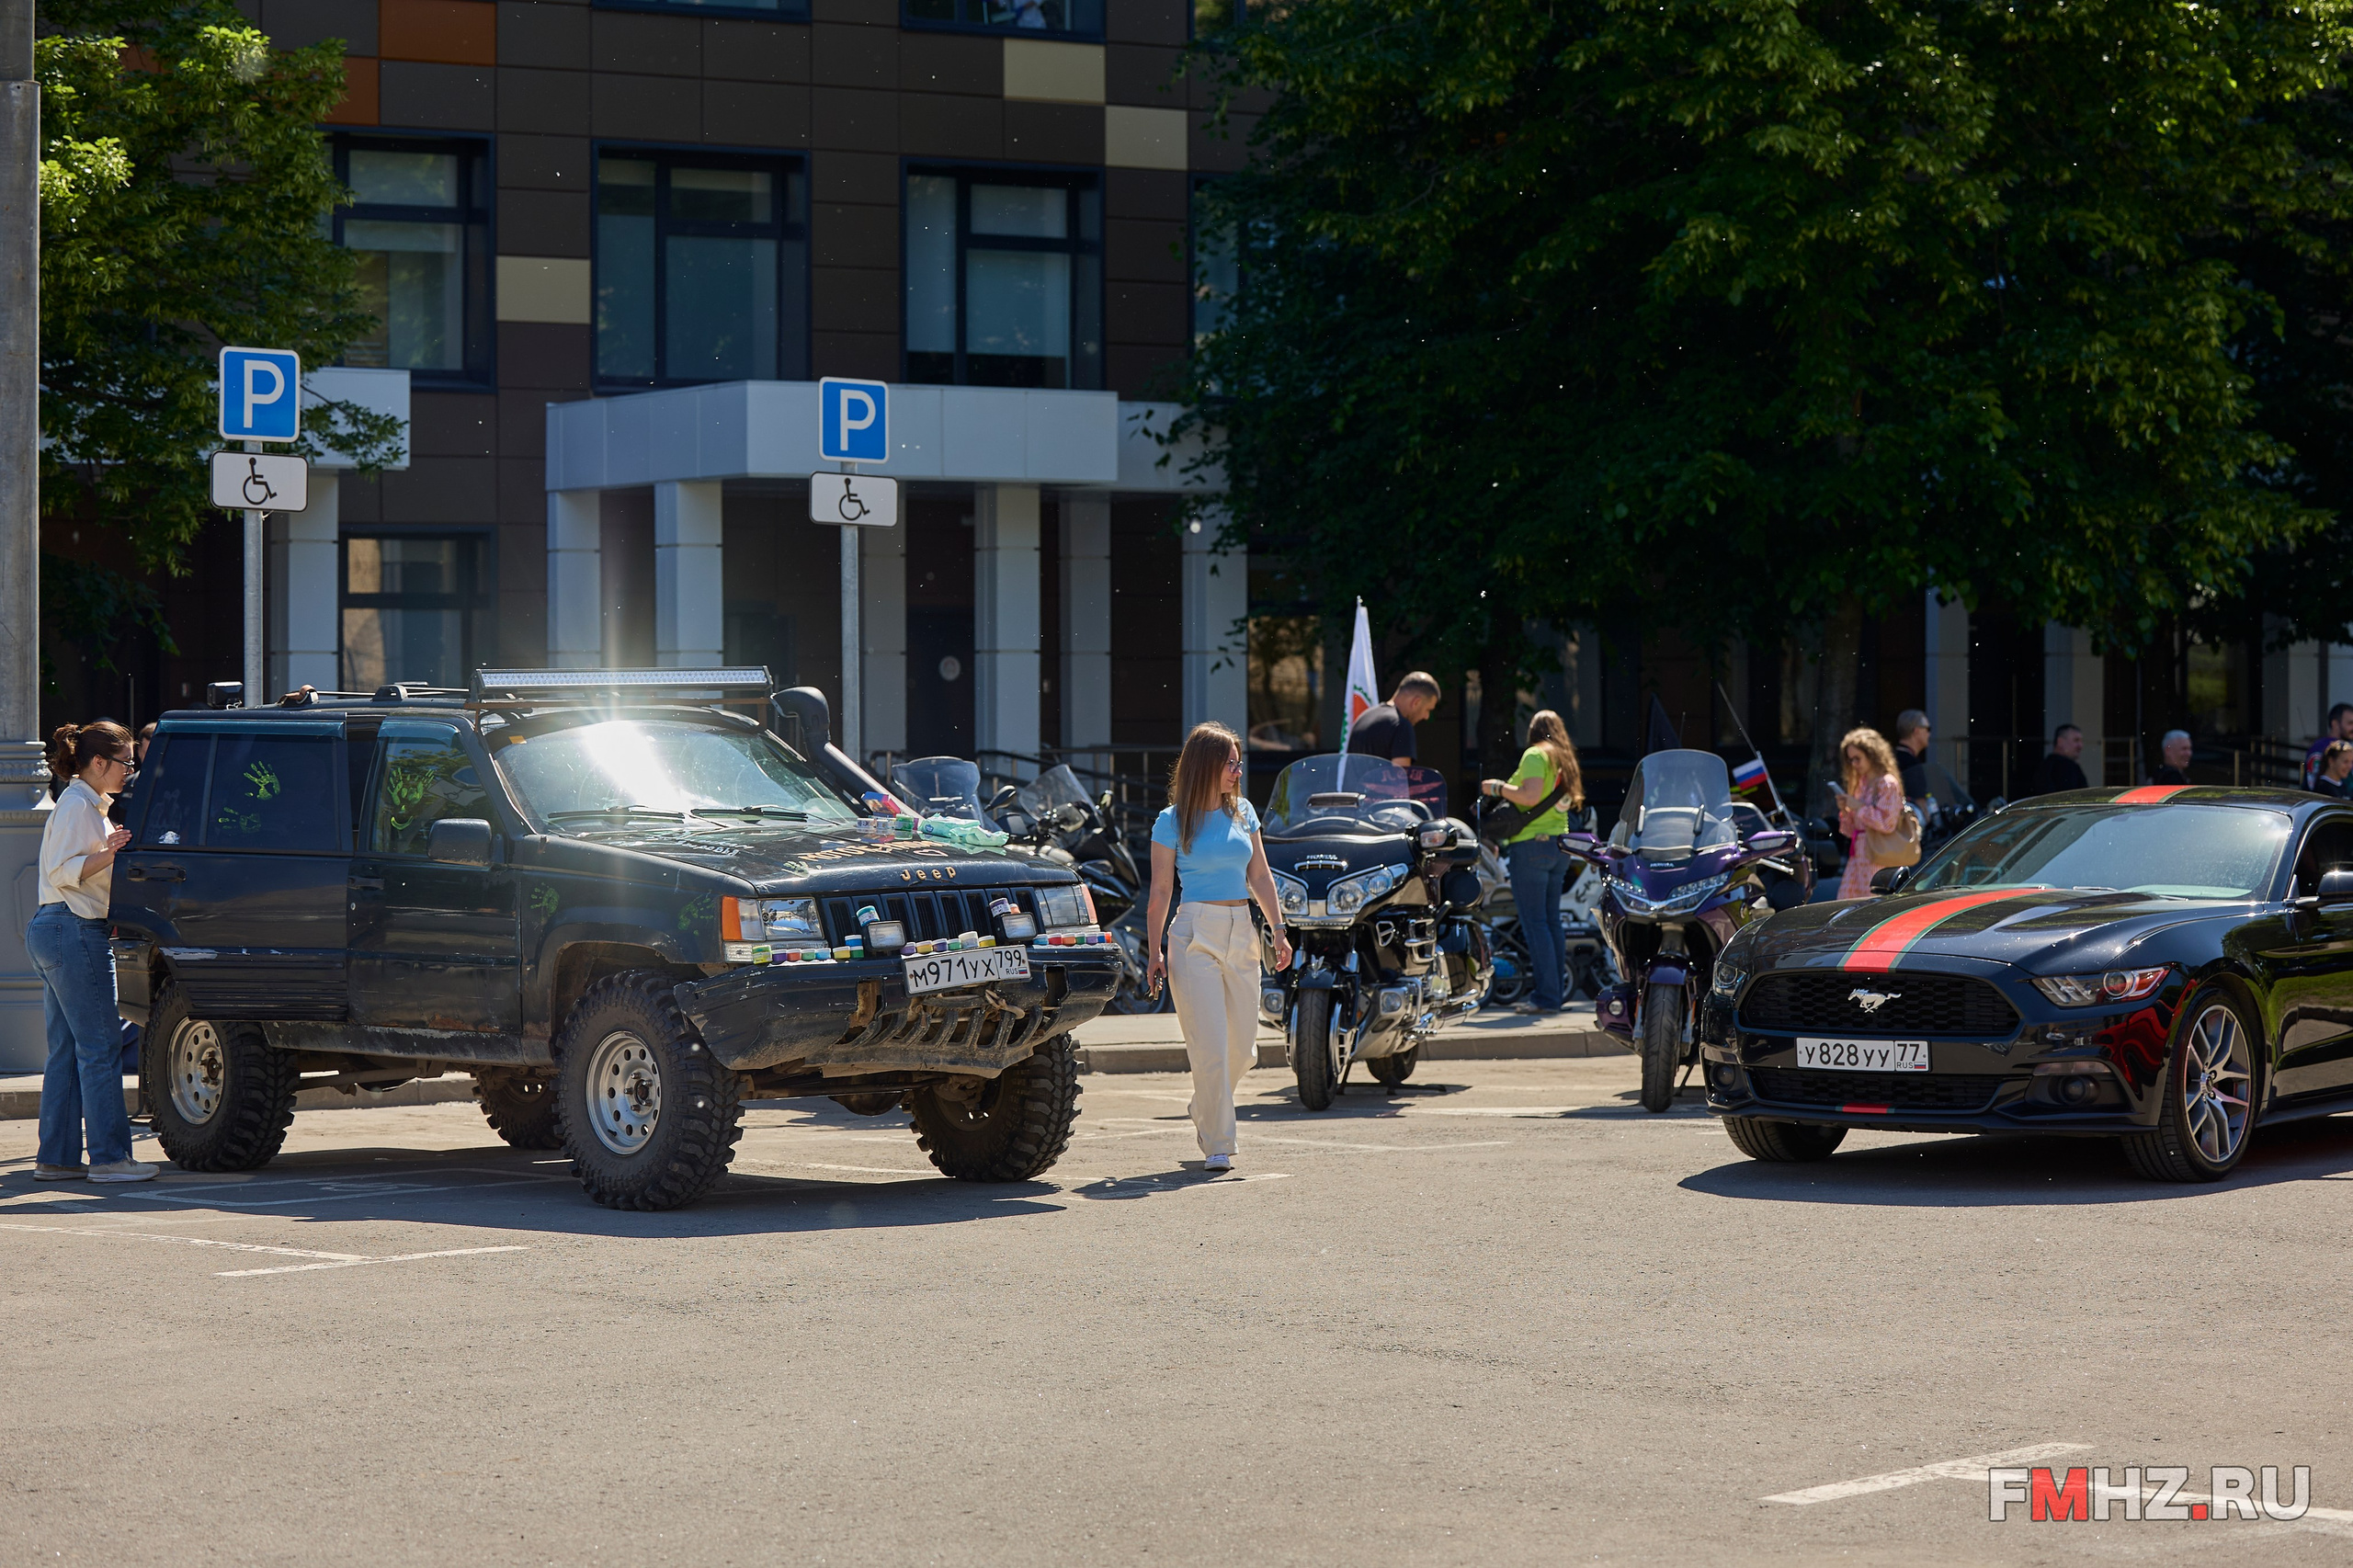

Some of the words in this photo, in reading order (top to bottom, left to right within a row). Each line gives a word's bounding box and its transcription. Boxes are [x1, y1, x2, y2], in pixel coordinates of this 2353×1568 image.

[244, 359, 285, 428] P
[840, 389, 876, 451] P
[900, 866, 956, 881] Jeep
[995, 949, 1022, 969] 799
[1897, 1043, 1920, 1062] 77
